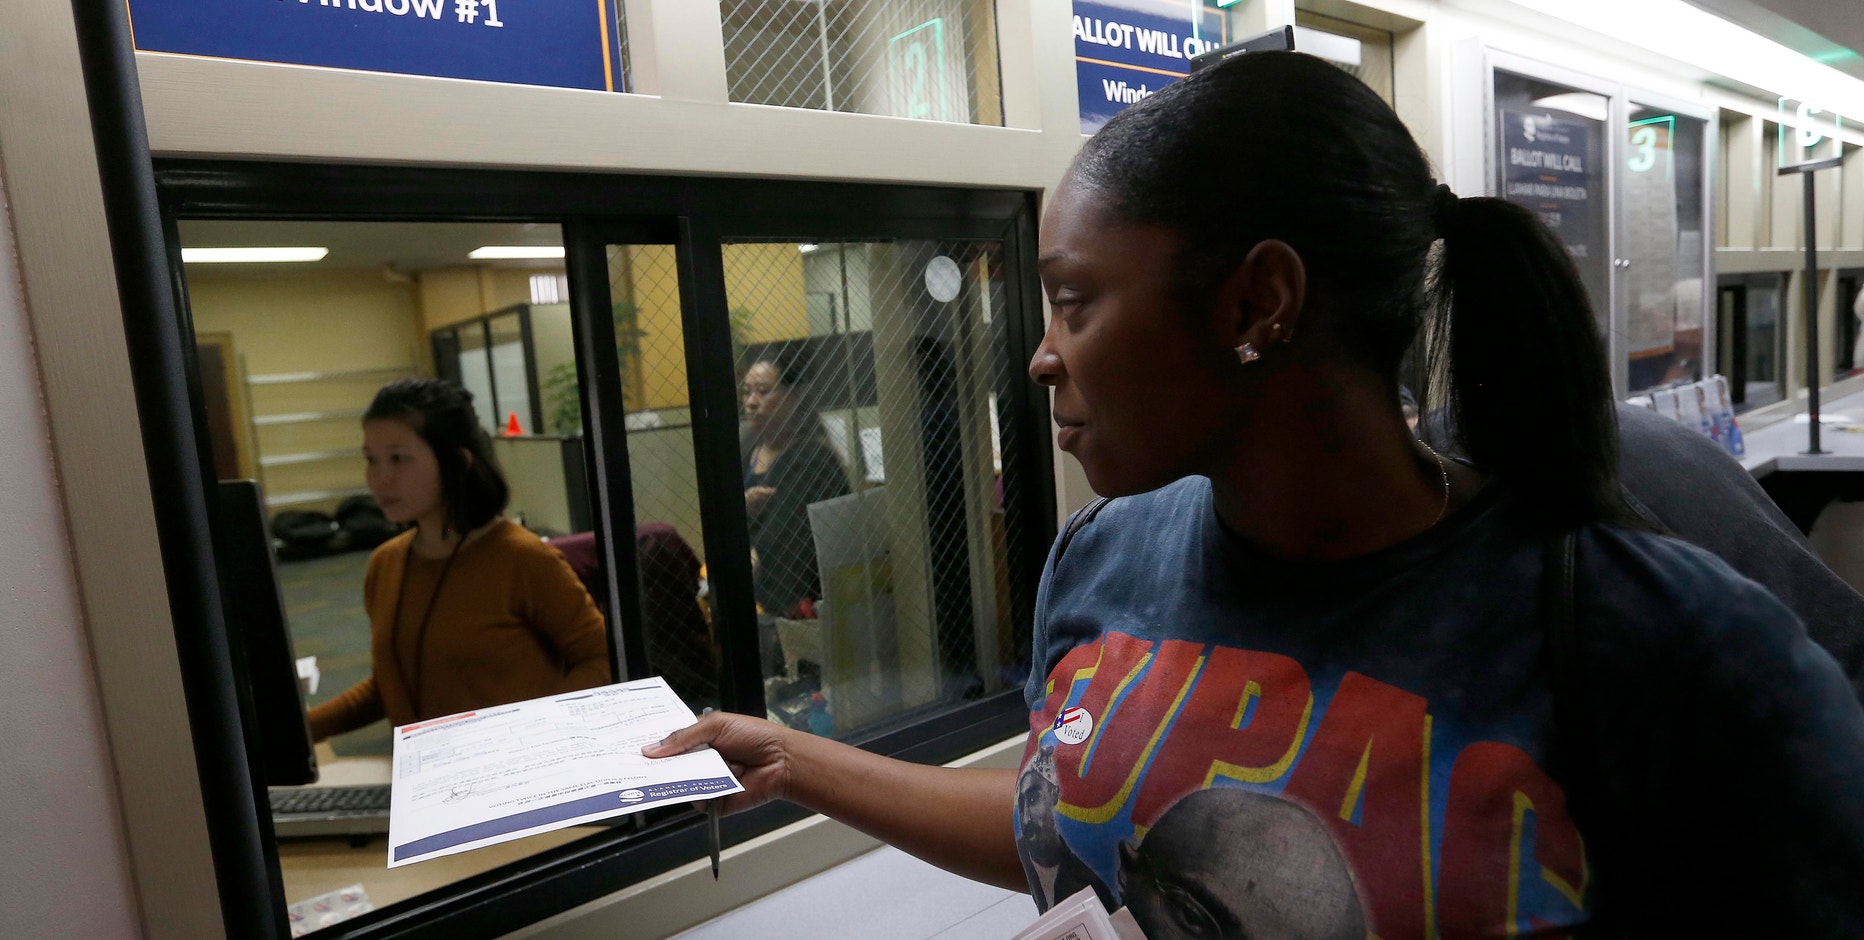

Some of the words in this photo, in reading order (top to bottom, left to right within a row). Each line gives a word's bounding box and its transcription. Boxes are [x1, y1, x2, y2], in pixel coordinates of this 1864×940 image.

[454, 0, 504, 28] #1
[1073, 15, 1135, 50] ALLOT
[1135, 27, 1183, 59] WILL
[1183, 37, 1220, 61] CA
[904, 42, 929, 119] 2
[1102, 78, 1154, 104] Wind
[1510, 147, 1542, 168] BALLOT
[1542, 153, 1563, 171] WILL
[1627, 127, 1657, 172] 3
[1079, 712, 1085, 723] I
[1064, 725, 1085, 740] Voted
[649, 787, 688, 798] Registrar
[689, 784, 700, 792] of
[699, 783, 728, 791] Voters
